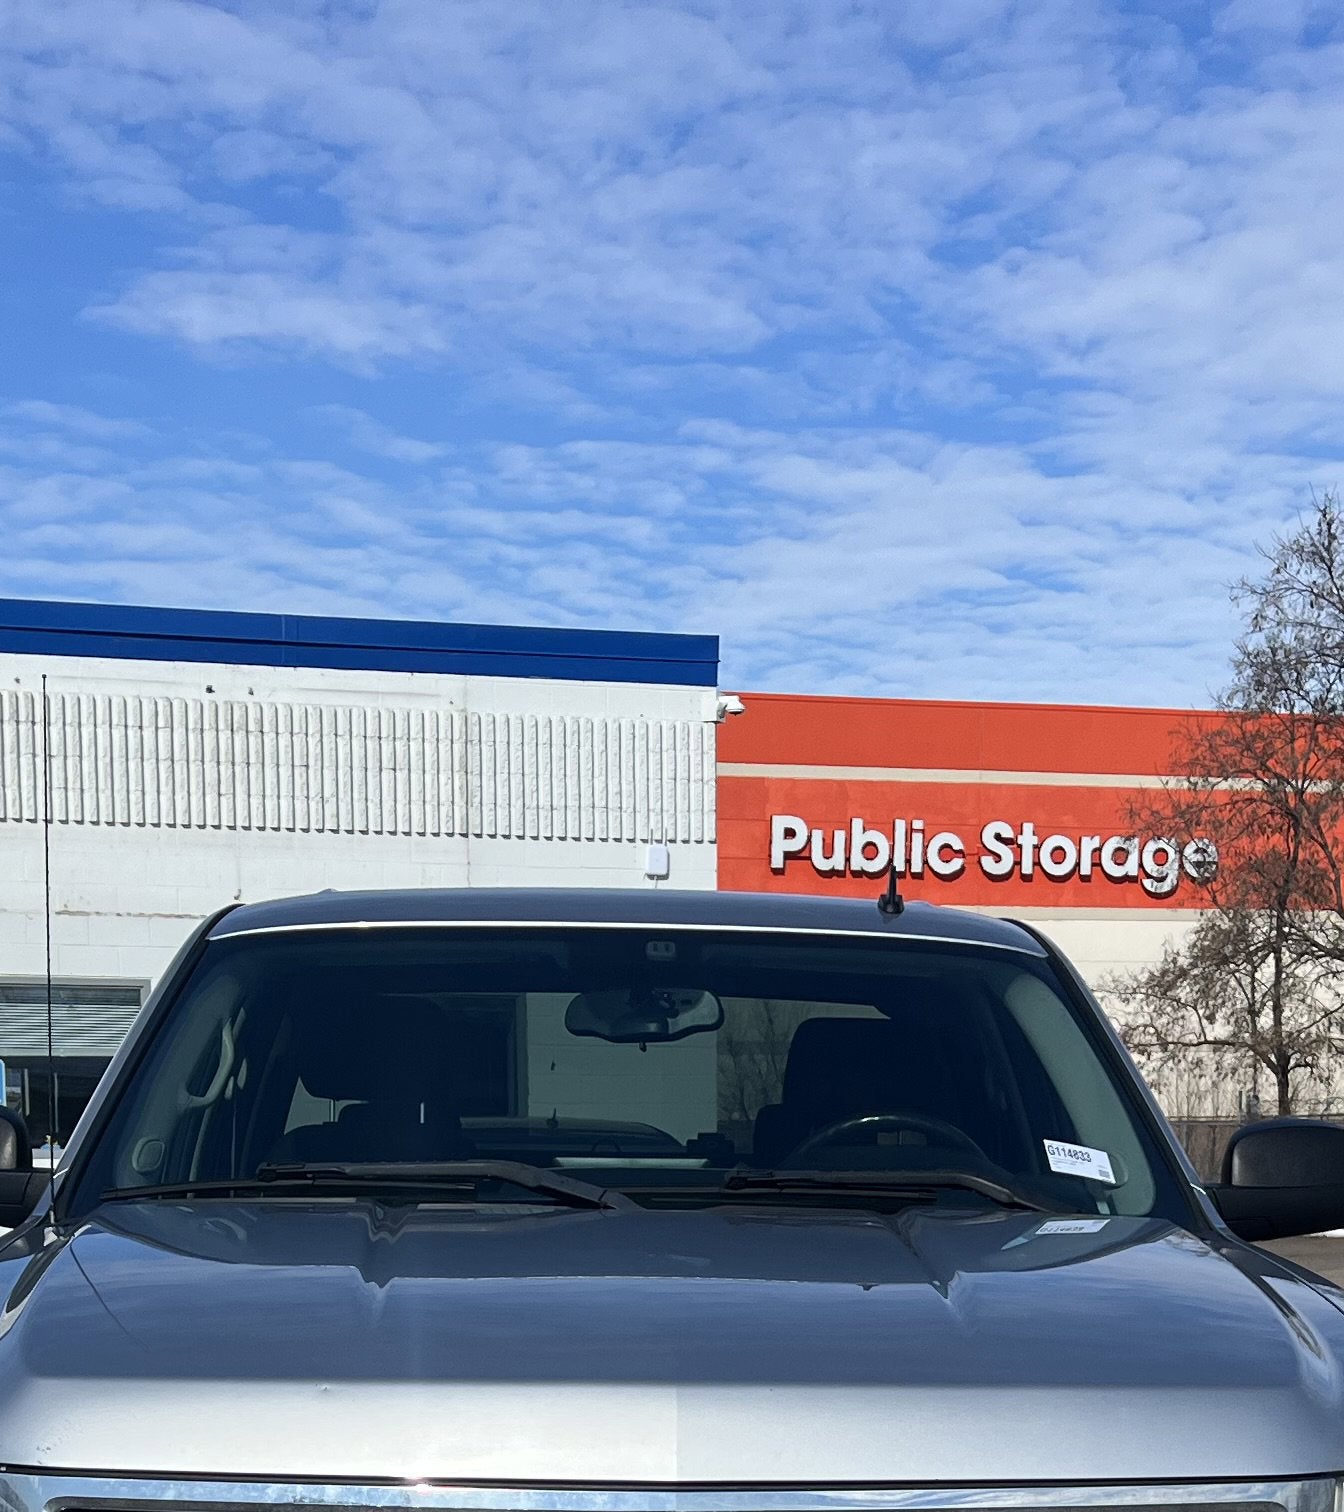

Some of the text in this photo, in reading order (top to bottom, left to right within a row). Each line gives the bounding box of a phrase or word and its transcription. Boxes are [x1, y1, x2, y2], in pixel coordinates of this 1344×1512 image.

[770, 814, 1218, 895] Public Storage
[1047, 1144, 1092, 1163] G114833
